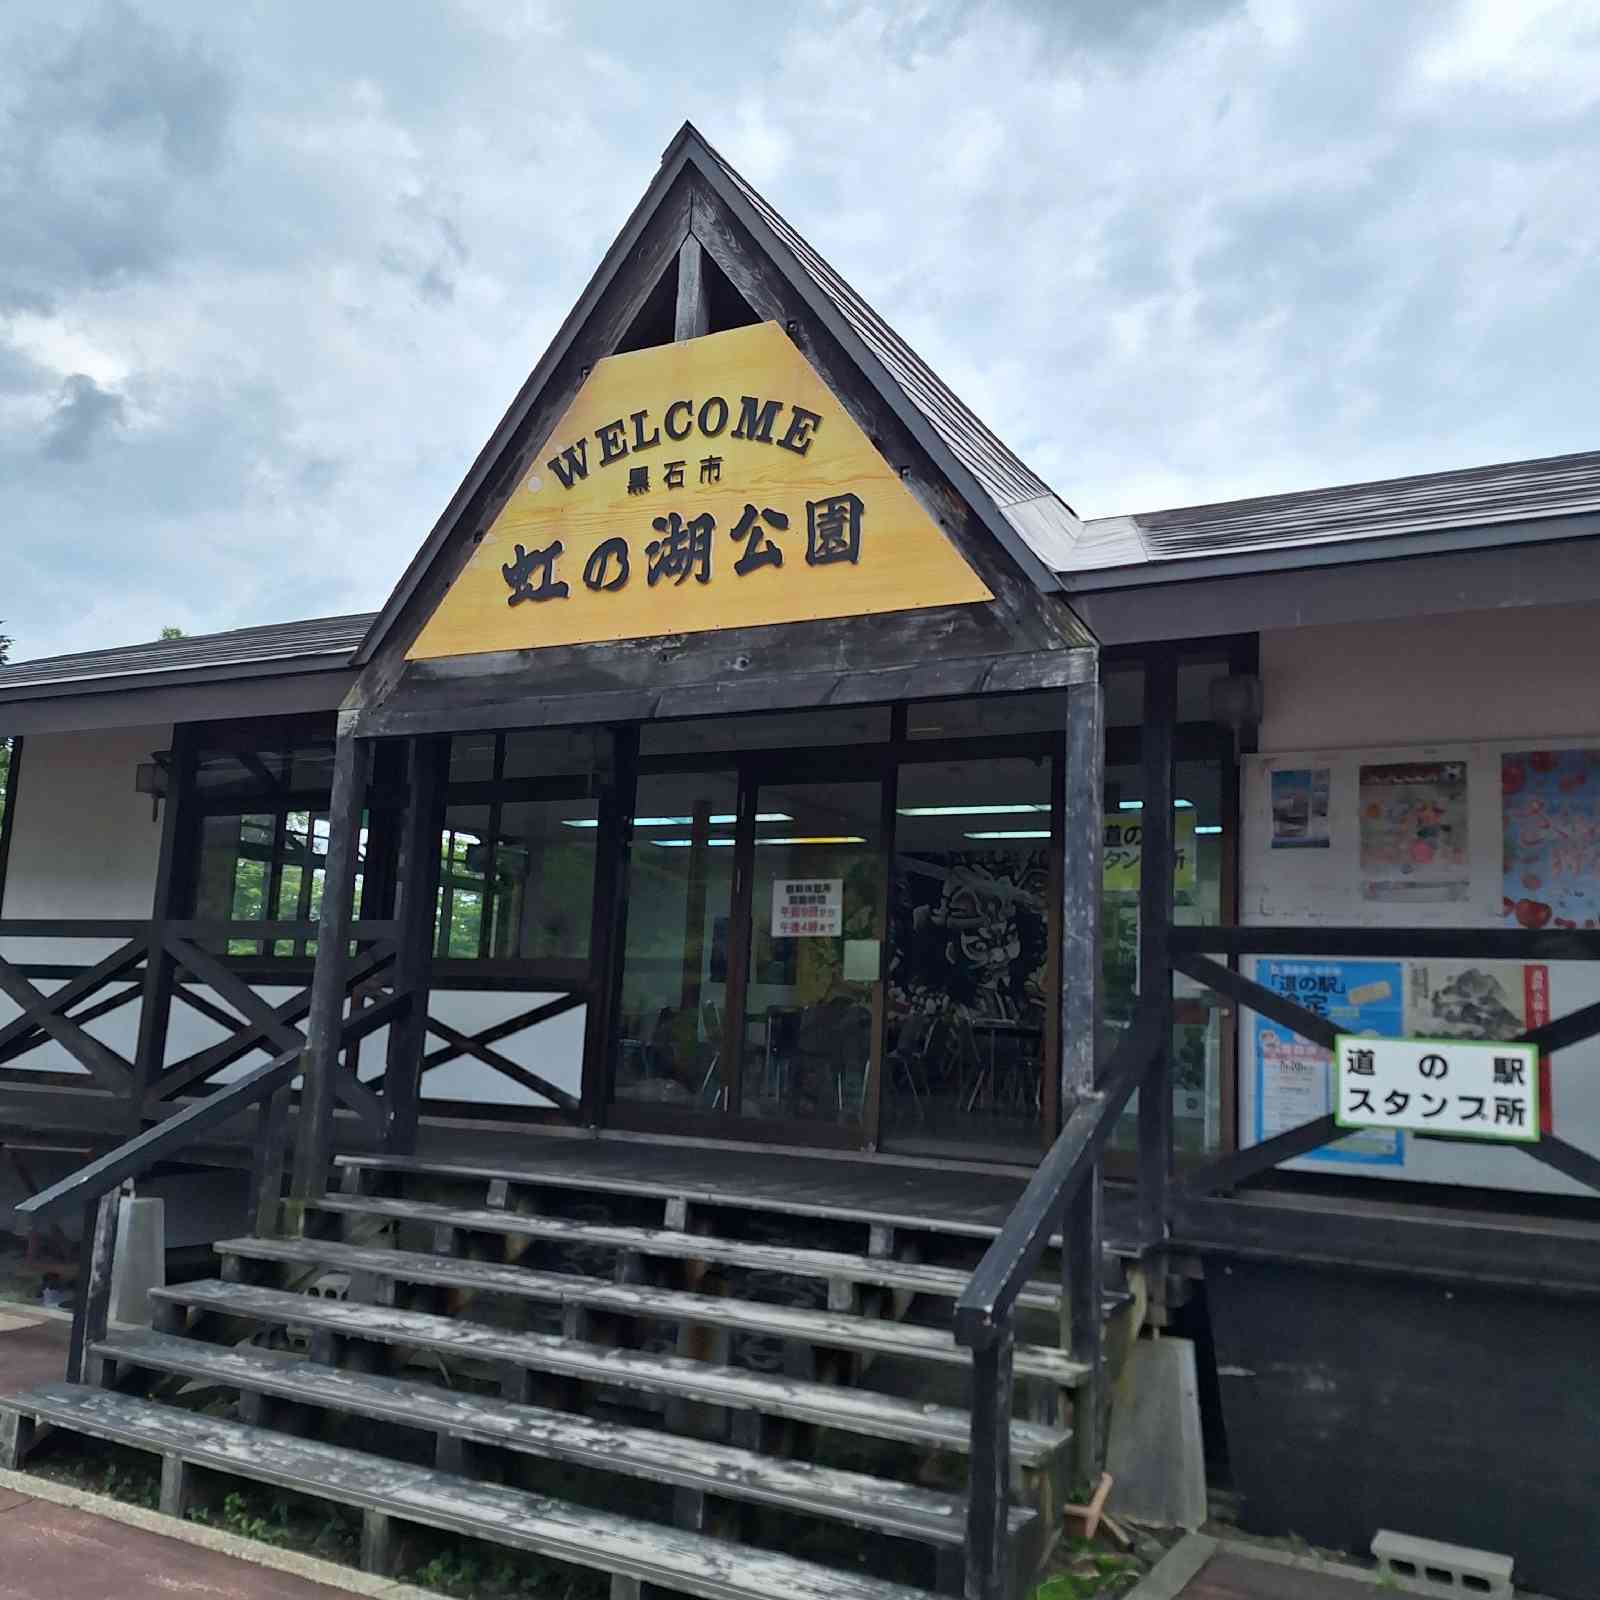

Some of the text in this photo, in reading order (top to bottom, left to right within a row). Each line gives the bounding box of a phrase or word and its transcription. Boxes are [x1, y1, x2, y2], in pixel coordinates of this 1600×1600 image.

[547, 396, 822, 490] WELCOME
[628, 455, 724, 496] 黒石市
[502, 493, 864, 606] 虹の湖公園
[1347, 1049, 1525, 1086] 道の駅
[1348, 1087, 1525, 1127] スタンプ所
